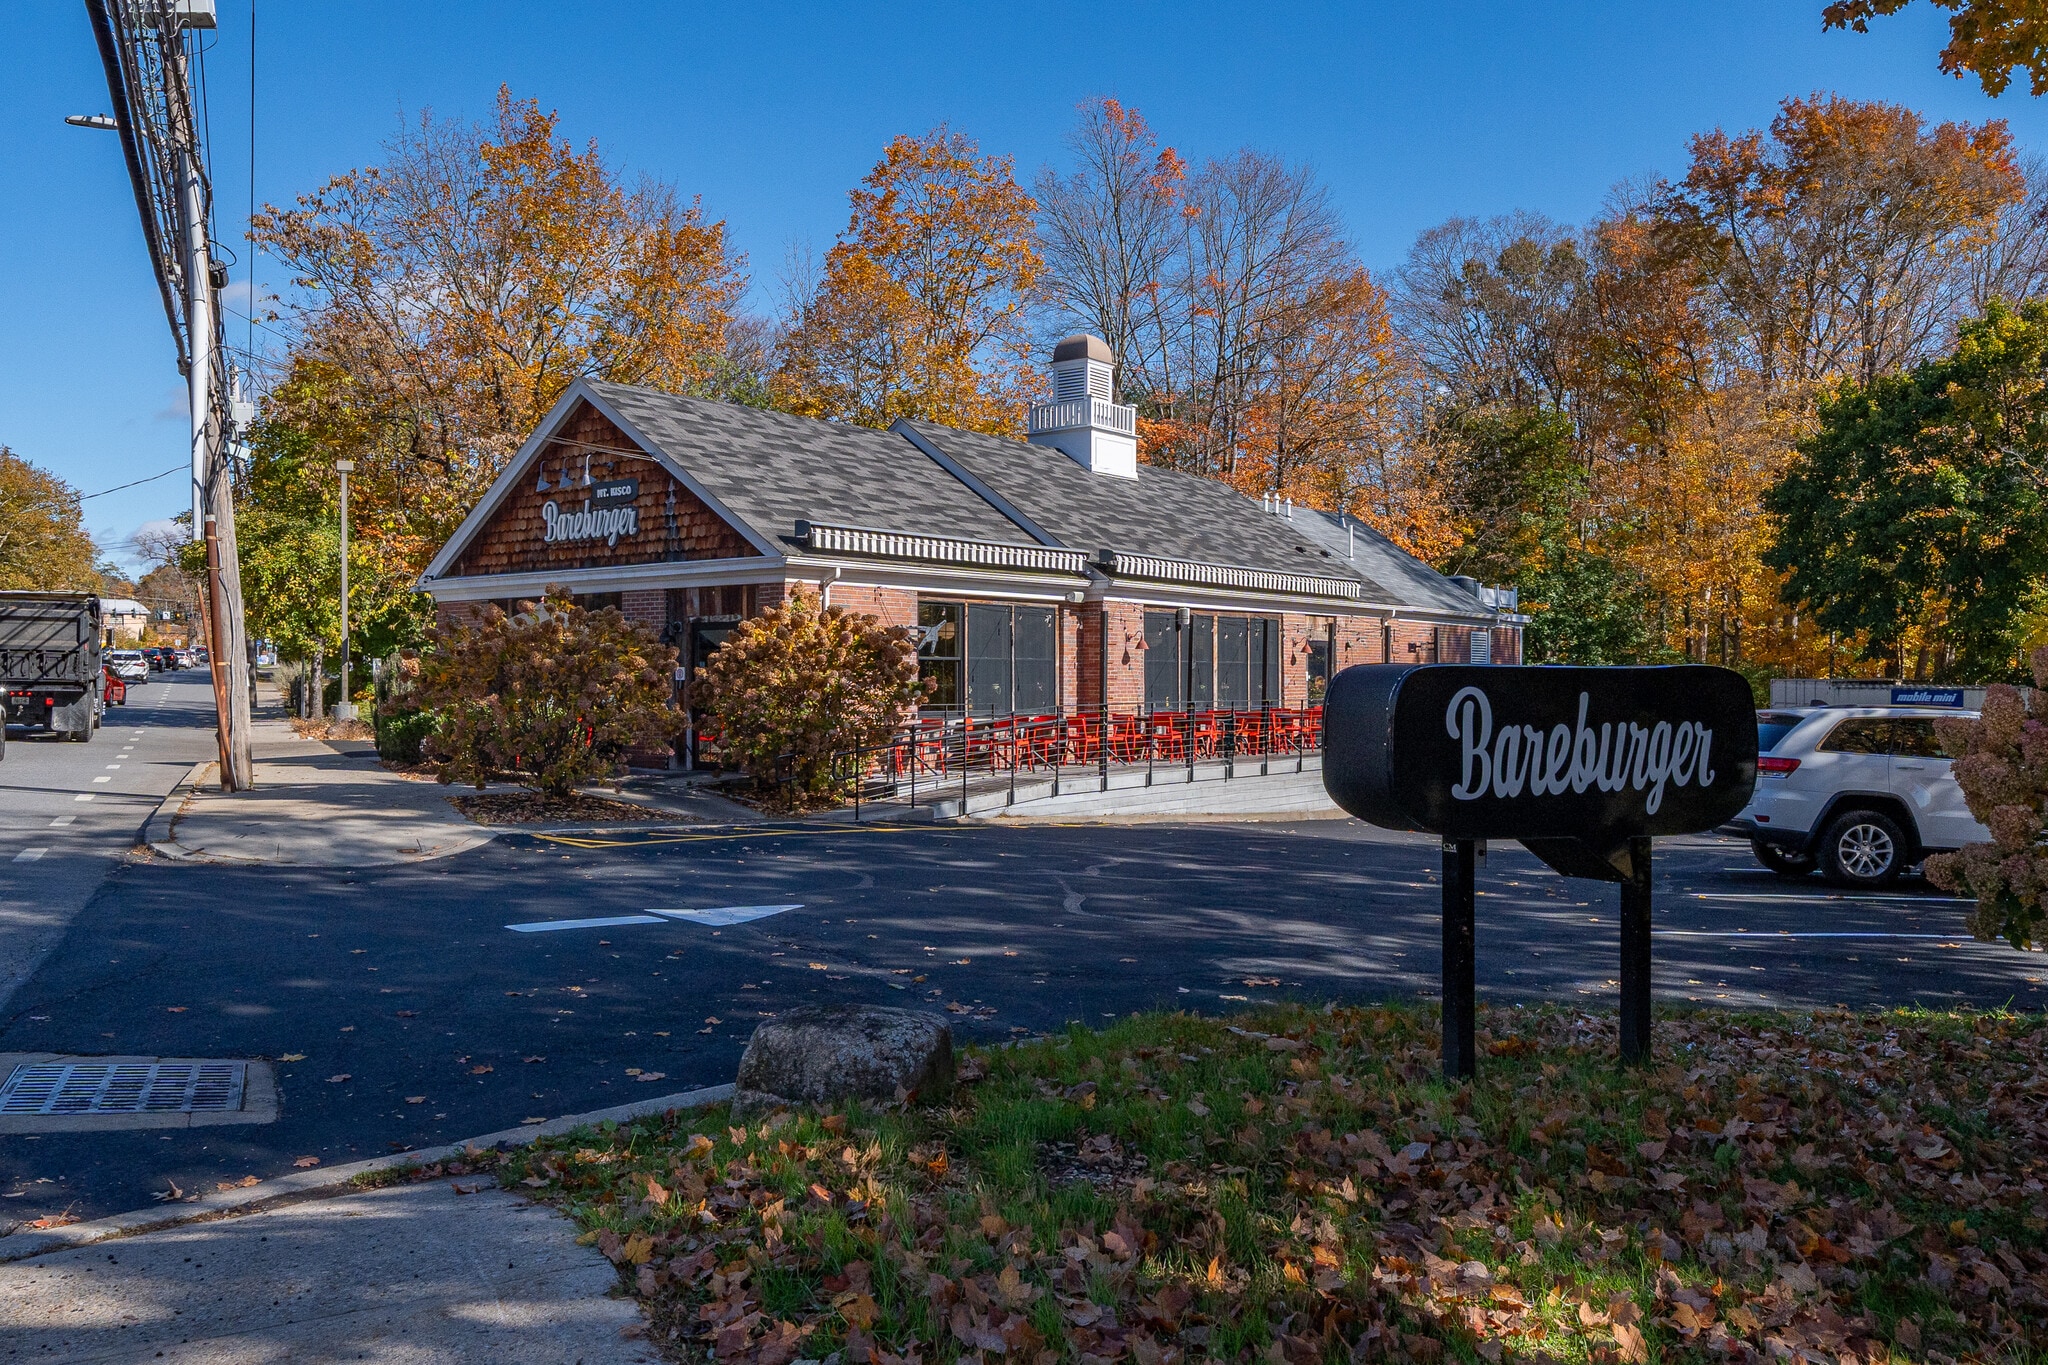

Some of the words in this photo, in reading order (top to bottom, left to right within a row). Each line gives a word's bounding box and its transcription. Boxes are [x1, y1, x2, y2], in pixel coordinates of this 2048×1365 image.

[597, 489, 609, 498] MT.
[610, 485, 632, 497] KISCO
[542, 499, 638, 546] Bareburger
[1897, 691, 1932, 702] mobile
[1932, 693, 1958, 703] mini
[1446, 686, 1715, 815] Bareburger
